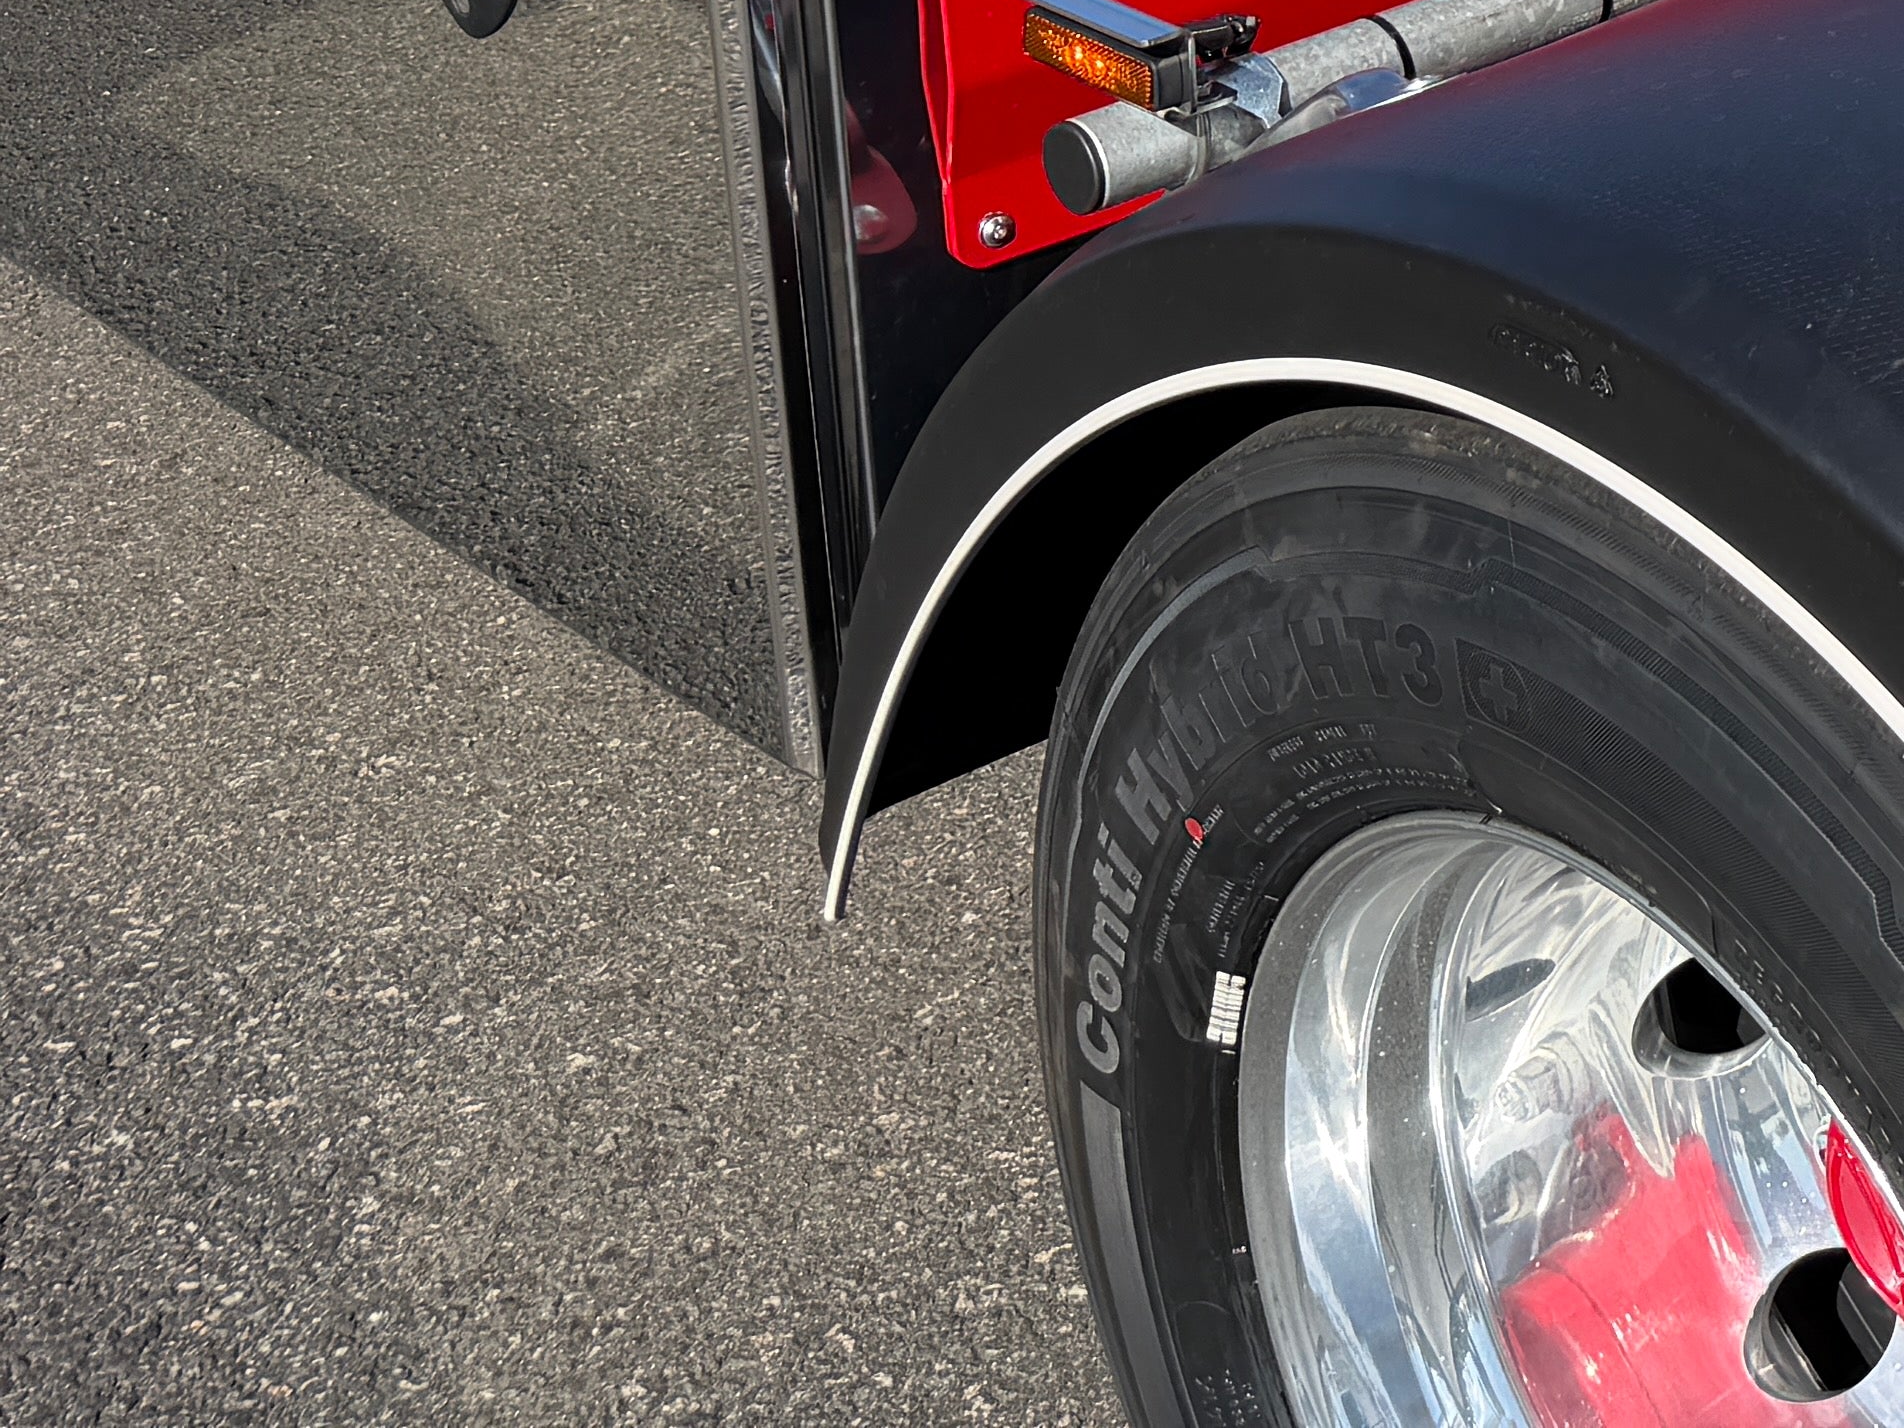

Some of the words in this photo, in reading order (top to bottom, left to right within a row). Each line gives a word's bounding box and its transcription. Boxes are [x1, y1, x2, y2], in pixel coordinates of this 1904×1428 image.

[1076, 822, 1143, 1075] Conti
[1114, 629, 1293, 845] Hybrid
[1287, 615, 1444, 708] HT3
